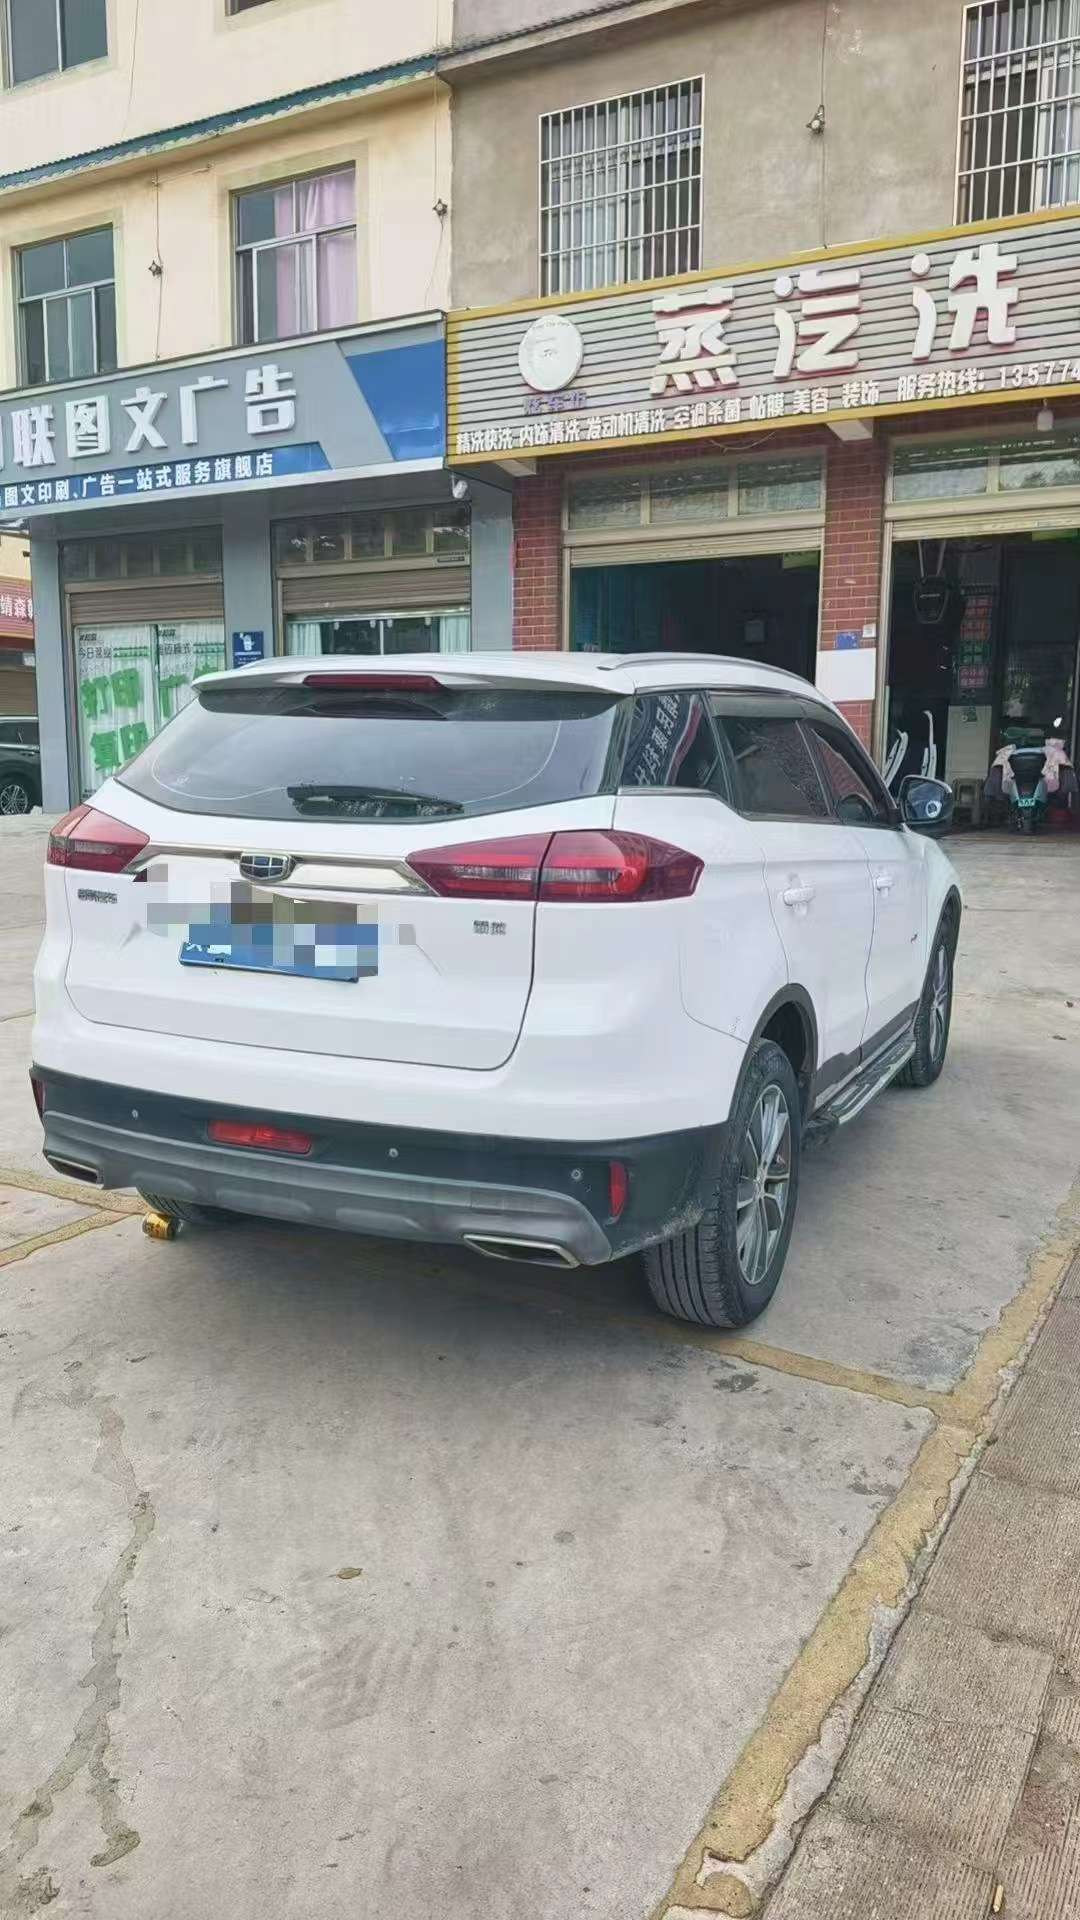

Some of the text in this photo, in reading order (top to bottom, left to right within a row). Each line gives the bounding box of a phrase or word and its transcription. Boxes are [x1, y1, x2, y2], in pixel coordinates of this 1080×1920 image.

[650, 243, 1019, 395] 蒸汽洗
[0, 364, 297, 471] 联图文广告
[674, 398, 742, 429] 空调杀菌
[793, 387, 829, 414] 美容
[842, 379, 880, 407] 装饰
[3, 452, 273, 507] 图文印刷、广告一站式服务旗舰店
